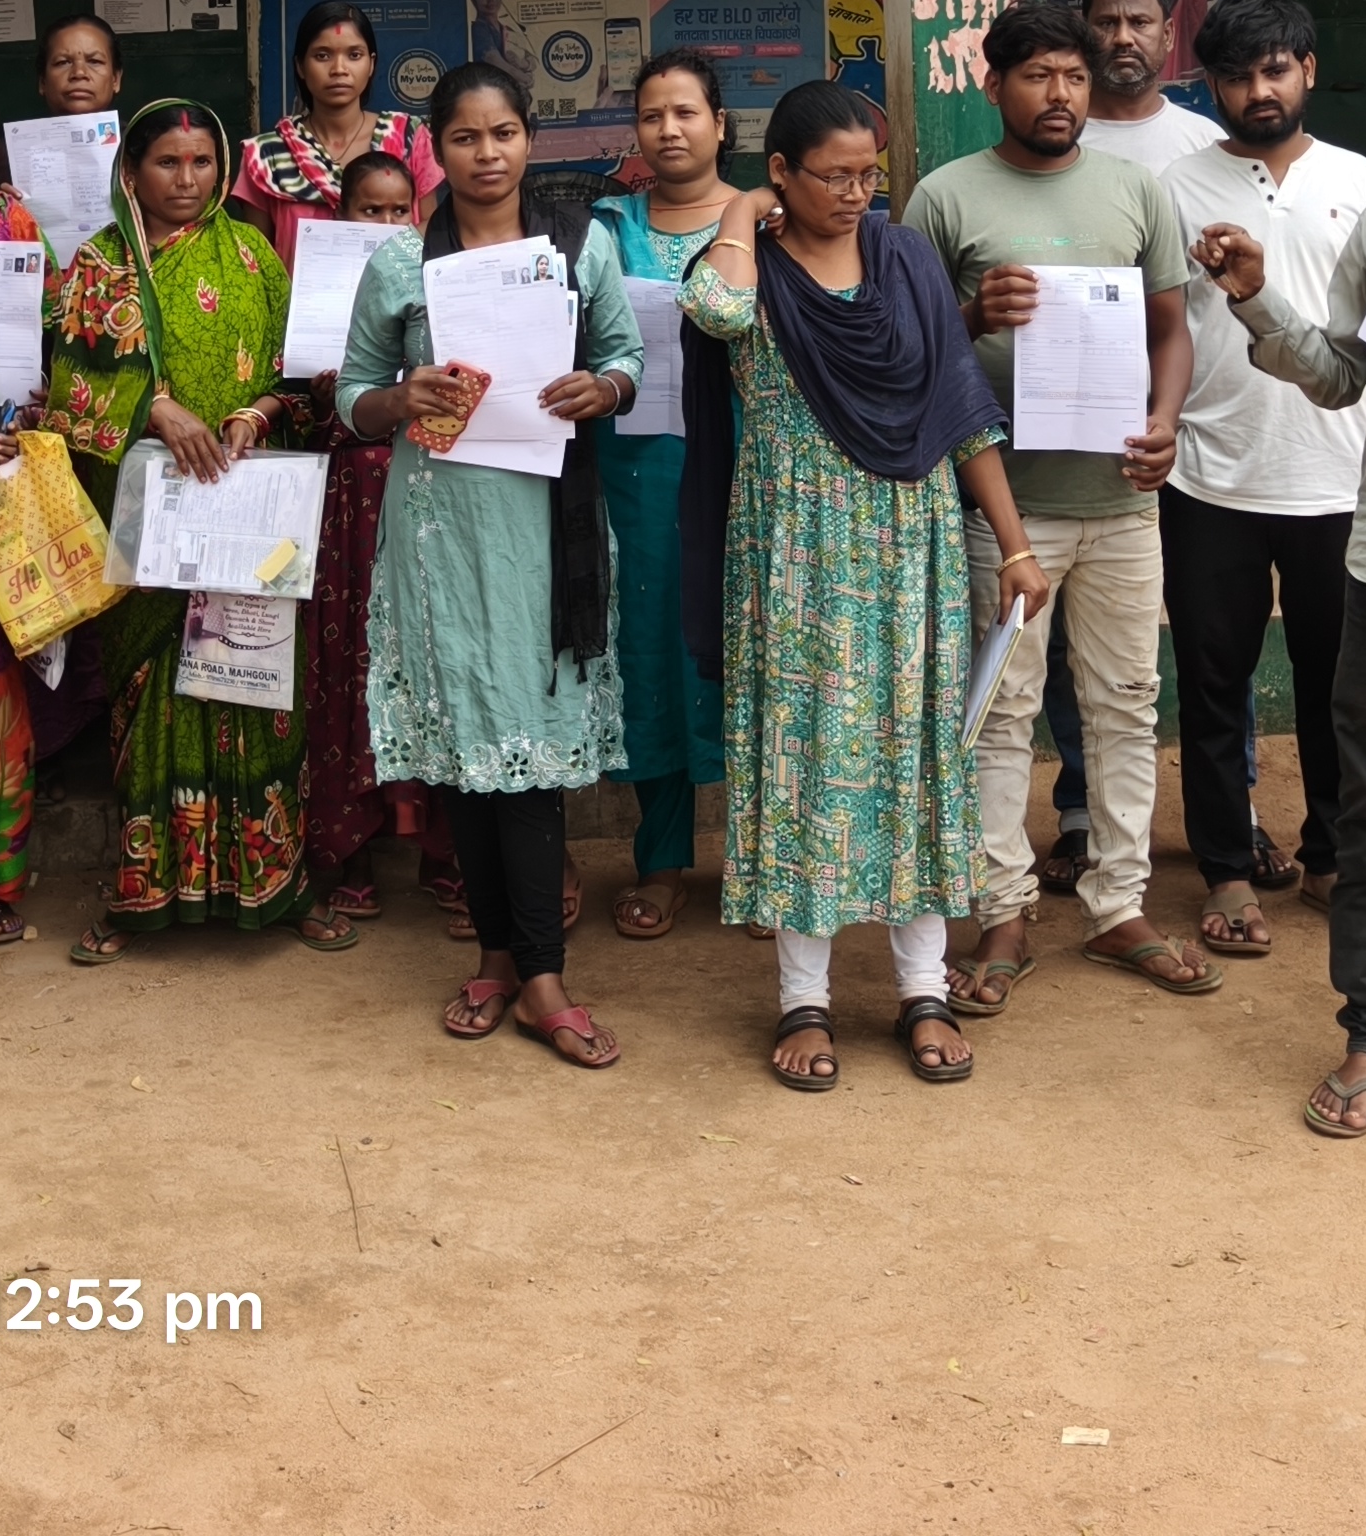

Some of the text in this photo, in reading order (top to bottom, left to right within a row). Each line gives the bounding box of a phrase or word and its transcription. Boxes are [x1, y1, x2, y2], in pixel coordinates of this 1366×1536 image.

[674, 8, 694, 26] हर
[697, 8, 719, 24] घर
[723, 7, 752, 24] BLO
[674, 29, 710, 41] मतदाता
[712, 29, 752, 40] STICKER
[551, 52, 584, 63] My Vote
[400, 74, 437, 85] My Vote
[200, 662, 227, 677] ROAD,
[228, 666, 278, 682] MAJHGOUN
